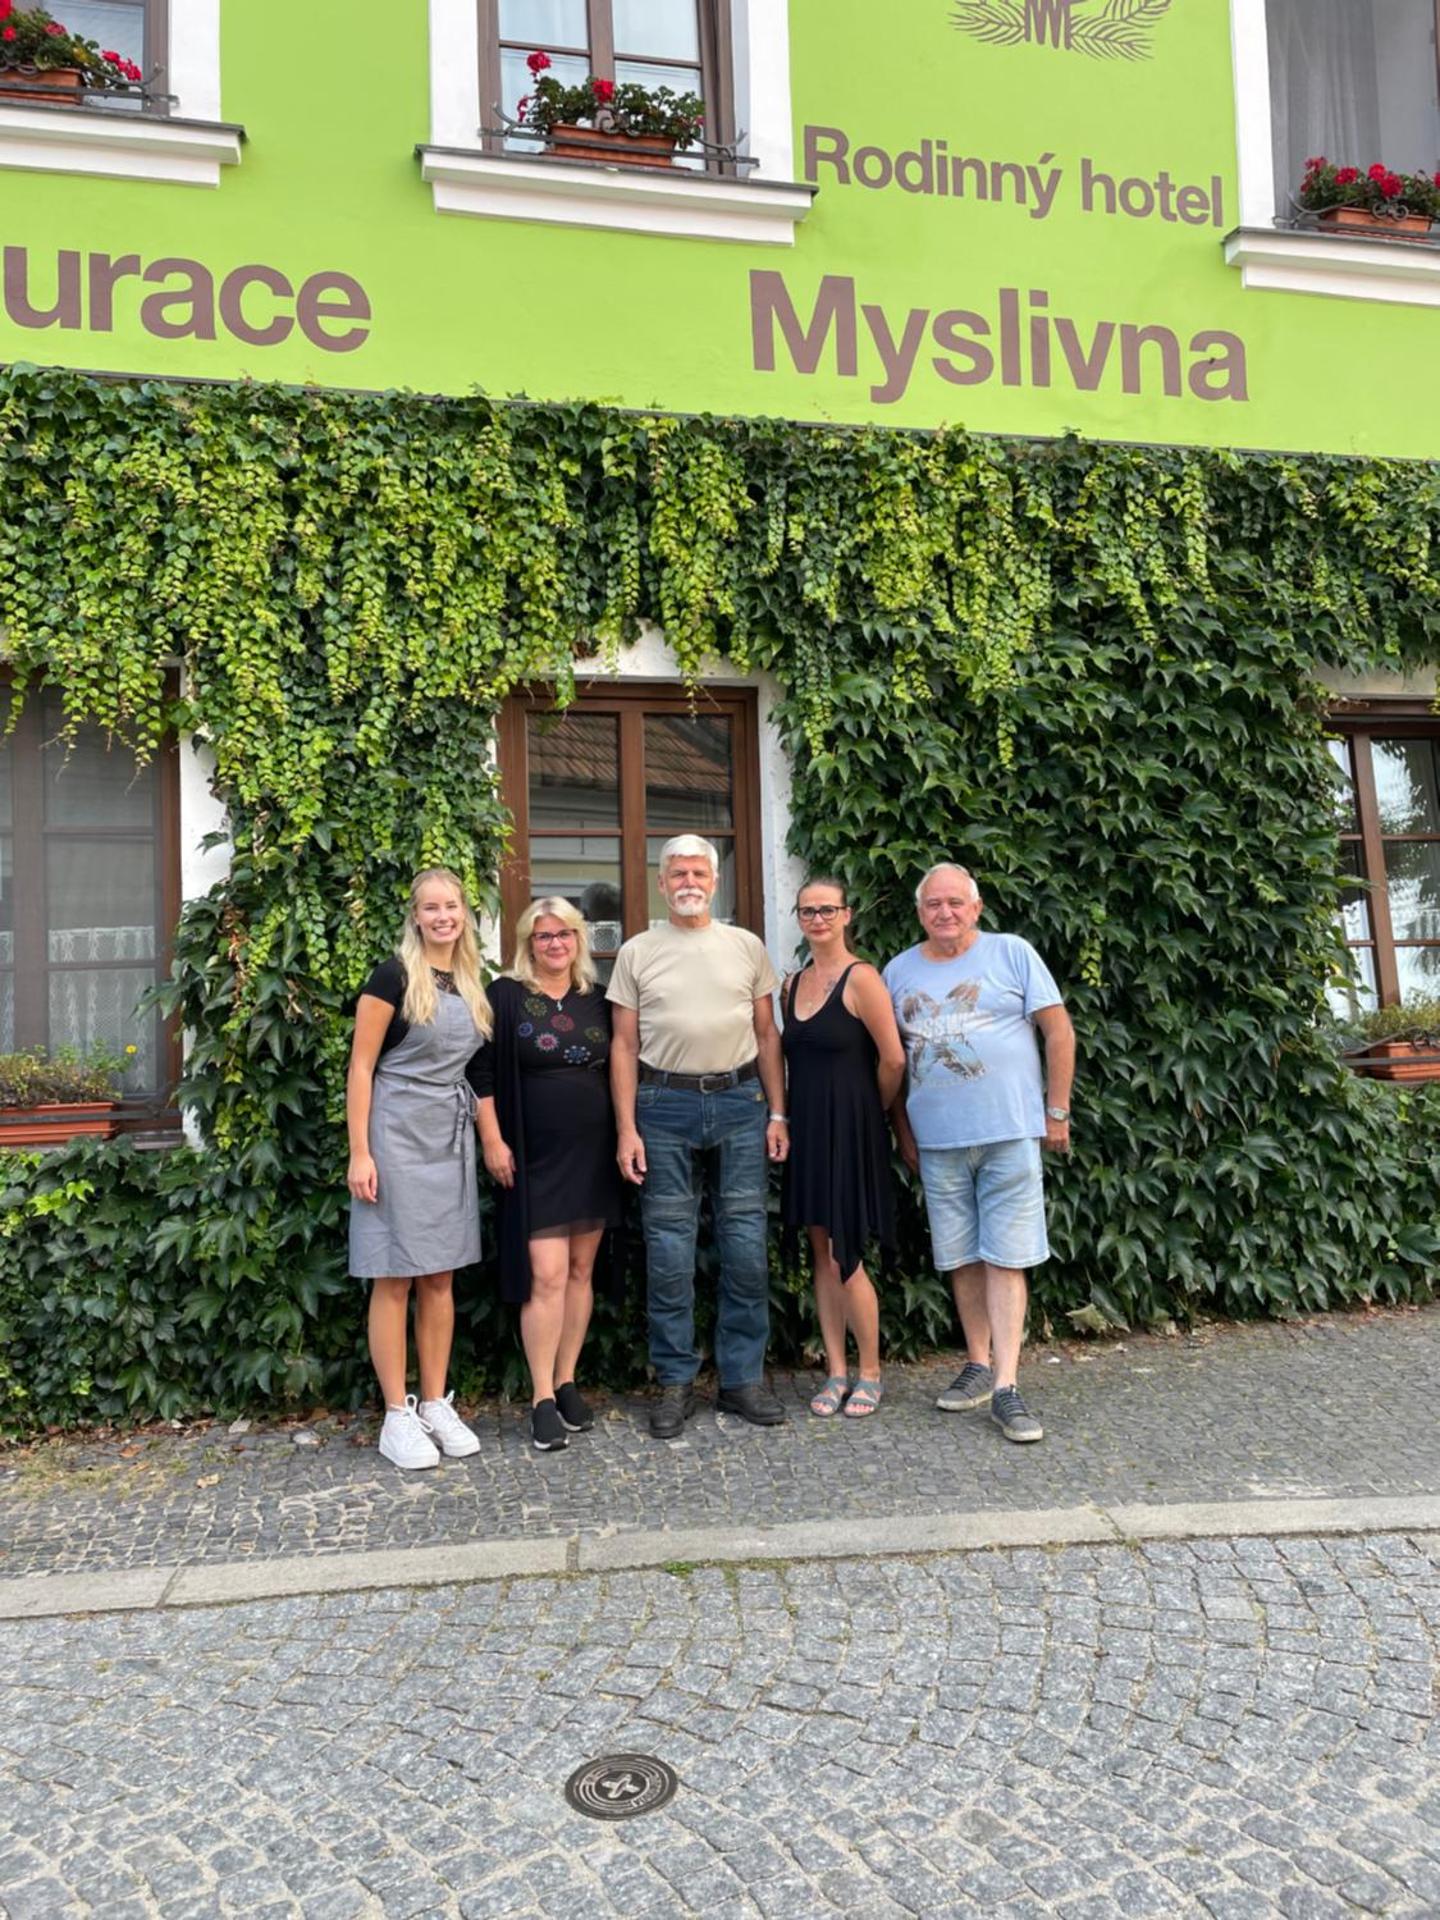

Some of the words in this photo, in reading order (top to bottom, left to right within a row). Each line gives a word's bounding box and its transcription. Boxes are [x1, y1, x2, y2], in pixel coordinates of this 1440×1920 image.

[803, 124, 1062, 220] Rodinný
[1081, 157, 1224, 229] hotel
[3, 245, 373, 354] urace
[749, 269, 1250, 406] Myslivna
